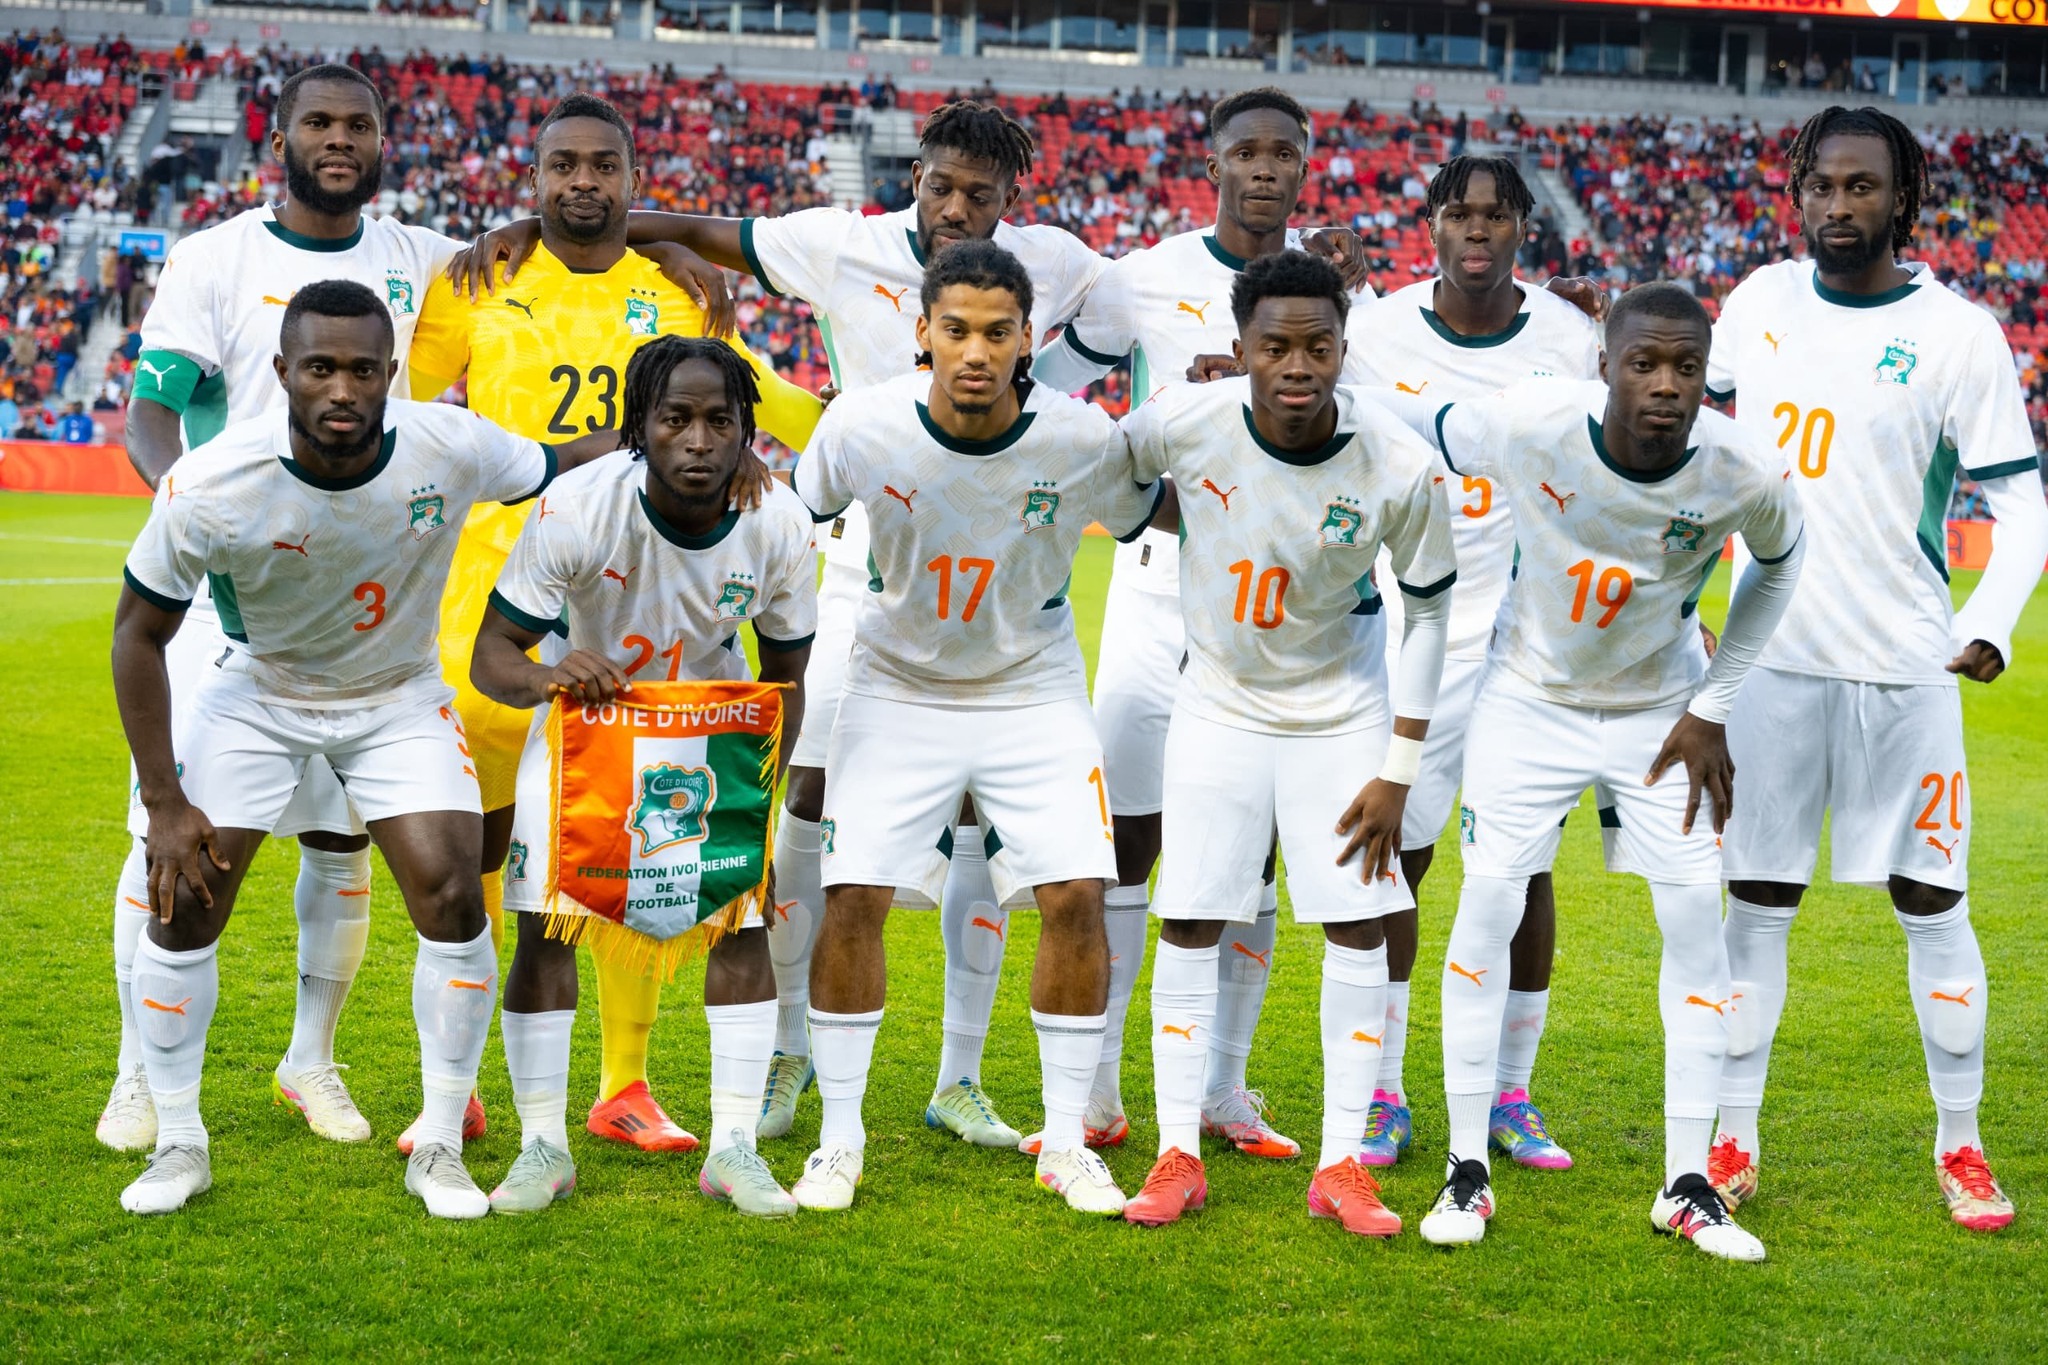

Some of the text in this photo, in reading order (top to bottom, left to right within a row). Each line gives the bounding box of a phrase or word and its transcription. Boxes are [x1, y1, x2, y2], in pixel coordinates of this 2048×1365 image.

[547, 364, 618, 434] 23
[1773, 401, 1835, 479] 20
[1462, 475, 1491, 519] 5
[353, 581, 386, 632] 3
[927, 554, 995, 623] 17
[1228, 559, 1290, 630] 10
[1566, 559, 1633, 630] 19
[622, 634, 684, 681] 21
[1088, 766, 1111, 827] 1
[1914, 771, 1963, 830] 20
[576, 855, 748, 880] FEDERATION IVOIRIENNE
[655, 882, 675, 894] DE
[627, 893, 697, 910] FOOTBALL
